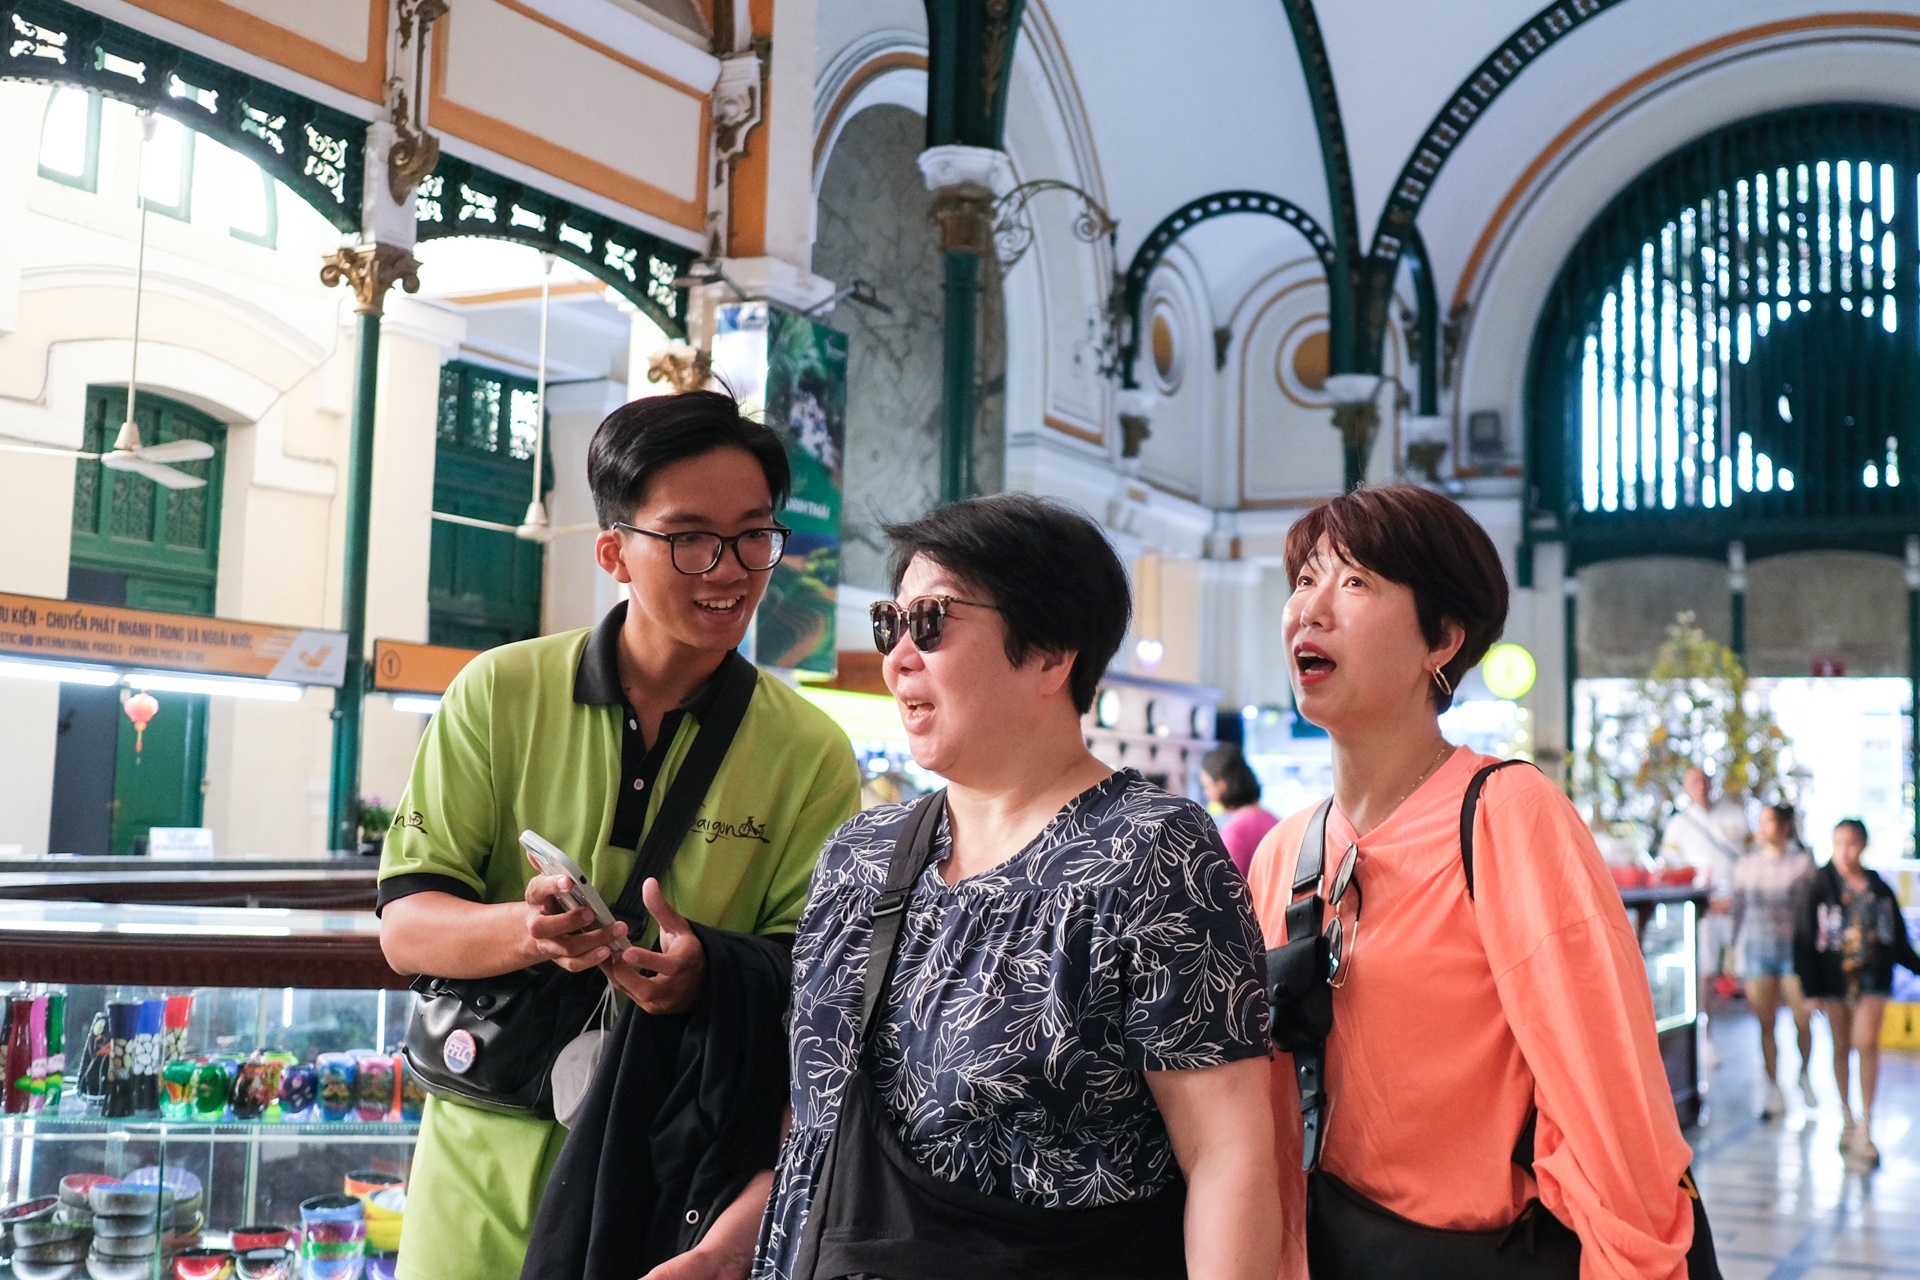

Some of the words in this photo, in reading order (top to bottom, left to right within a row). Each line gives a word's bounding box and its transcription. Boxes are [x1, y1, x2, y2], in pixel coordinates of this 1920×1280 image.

[12, 605, 37, 628] KIỆN
[90, 614, 116, 634] PHÁT
[118, 619, 152, 638] NHANH
[155, 623, 185, 642] TRONG
